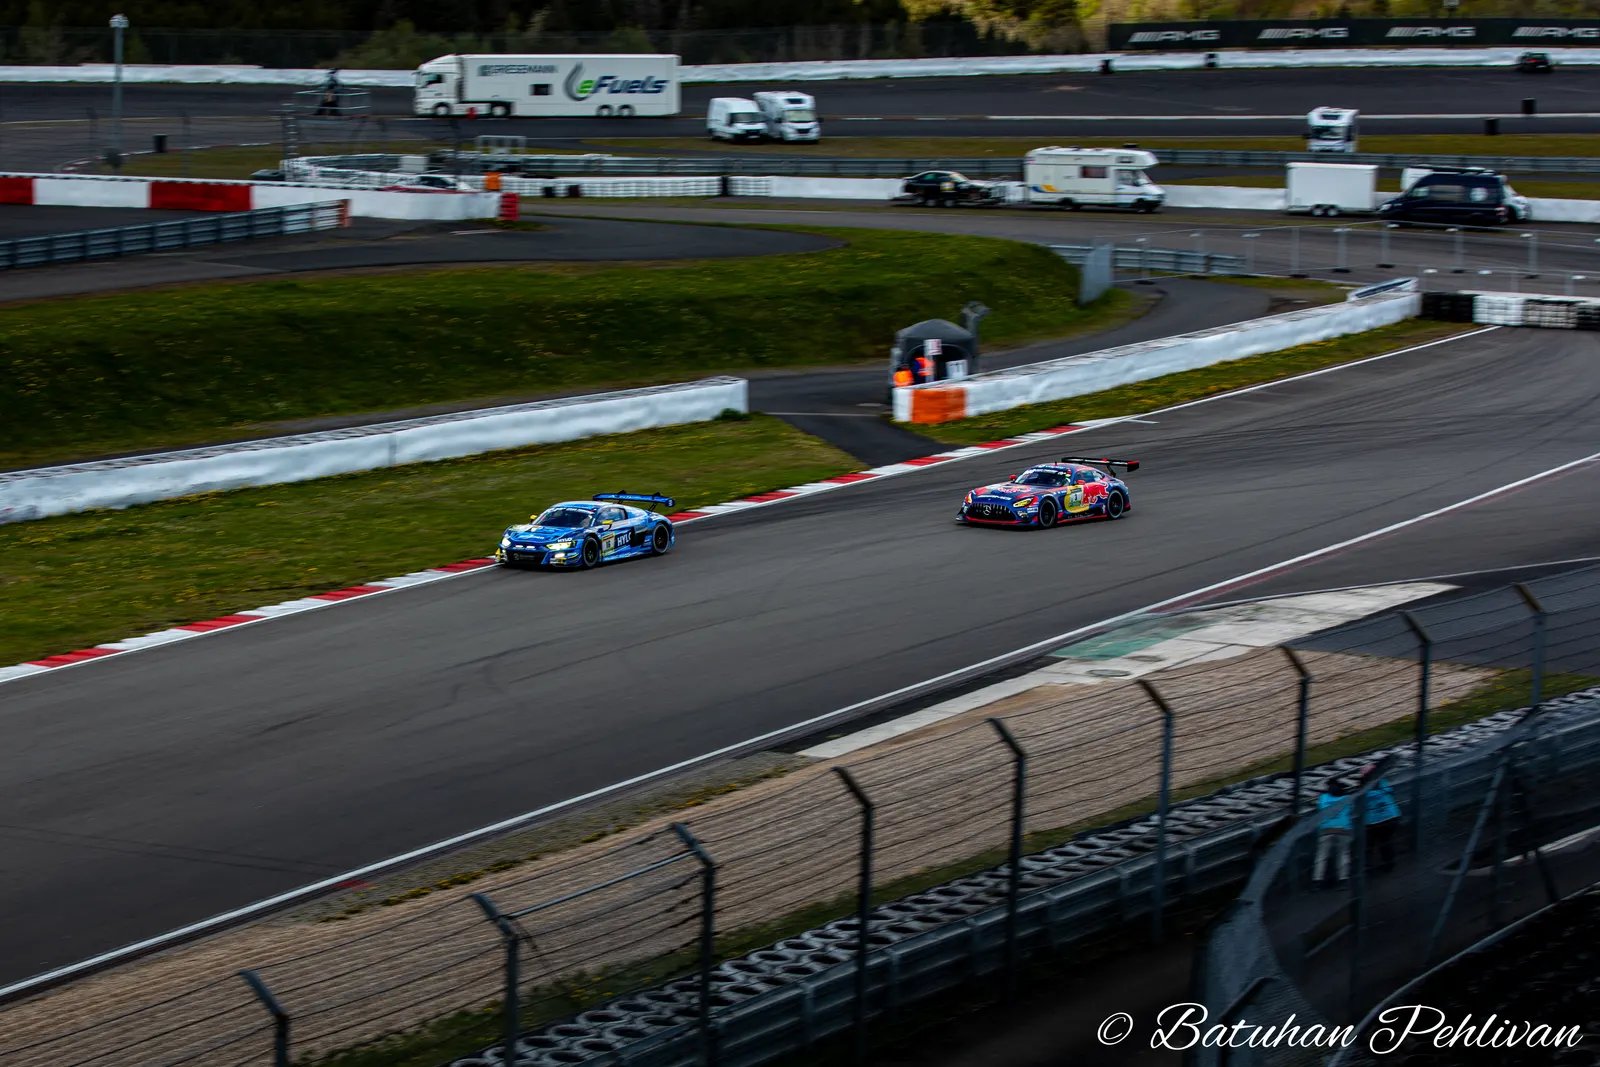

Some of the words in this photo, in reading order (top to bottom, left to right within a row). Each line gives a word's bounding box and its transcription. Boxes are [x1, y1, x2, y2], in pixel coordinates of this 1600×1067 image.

[1158, 29, 1220, 41] AMG
[1285, 27, 1349, 39] AMG
[1411, 26, 1476, 38] AMG
[1538, 26, 1600, 38] AMG
[576, 75, 671, 94] eFuels
